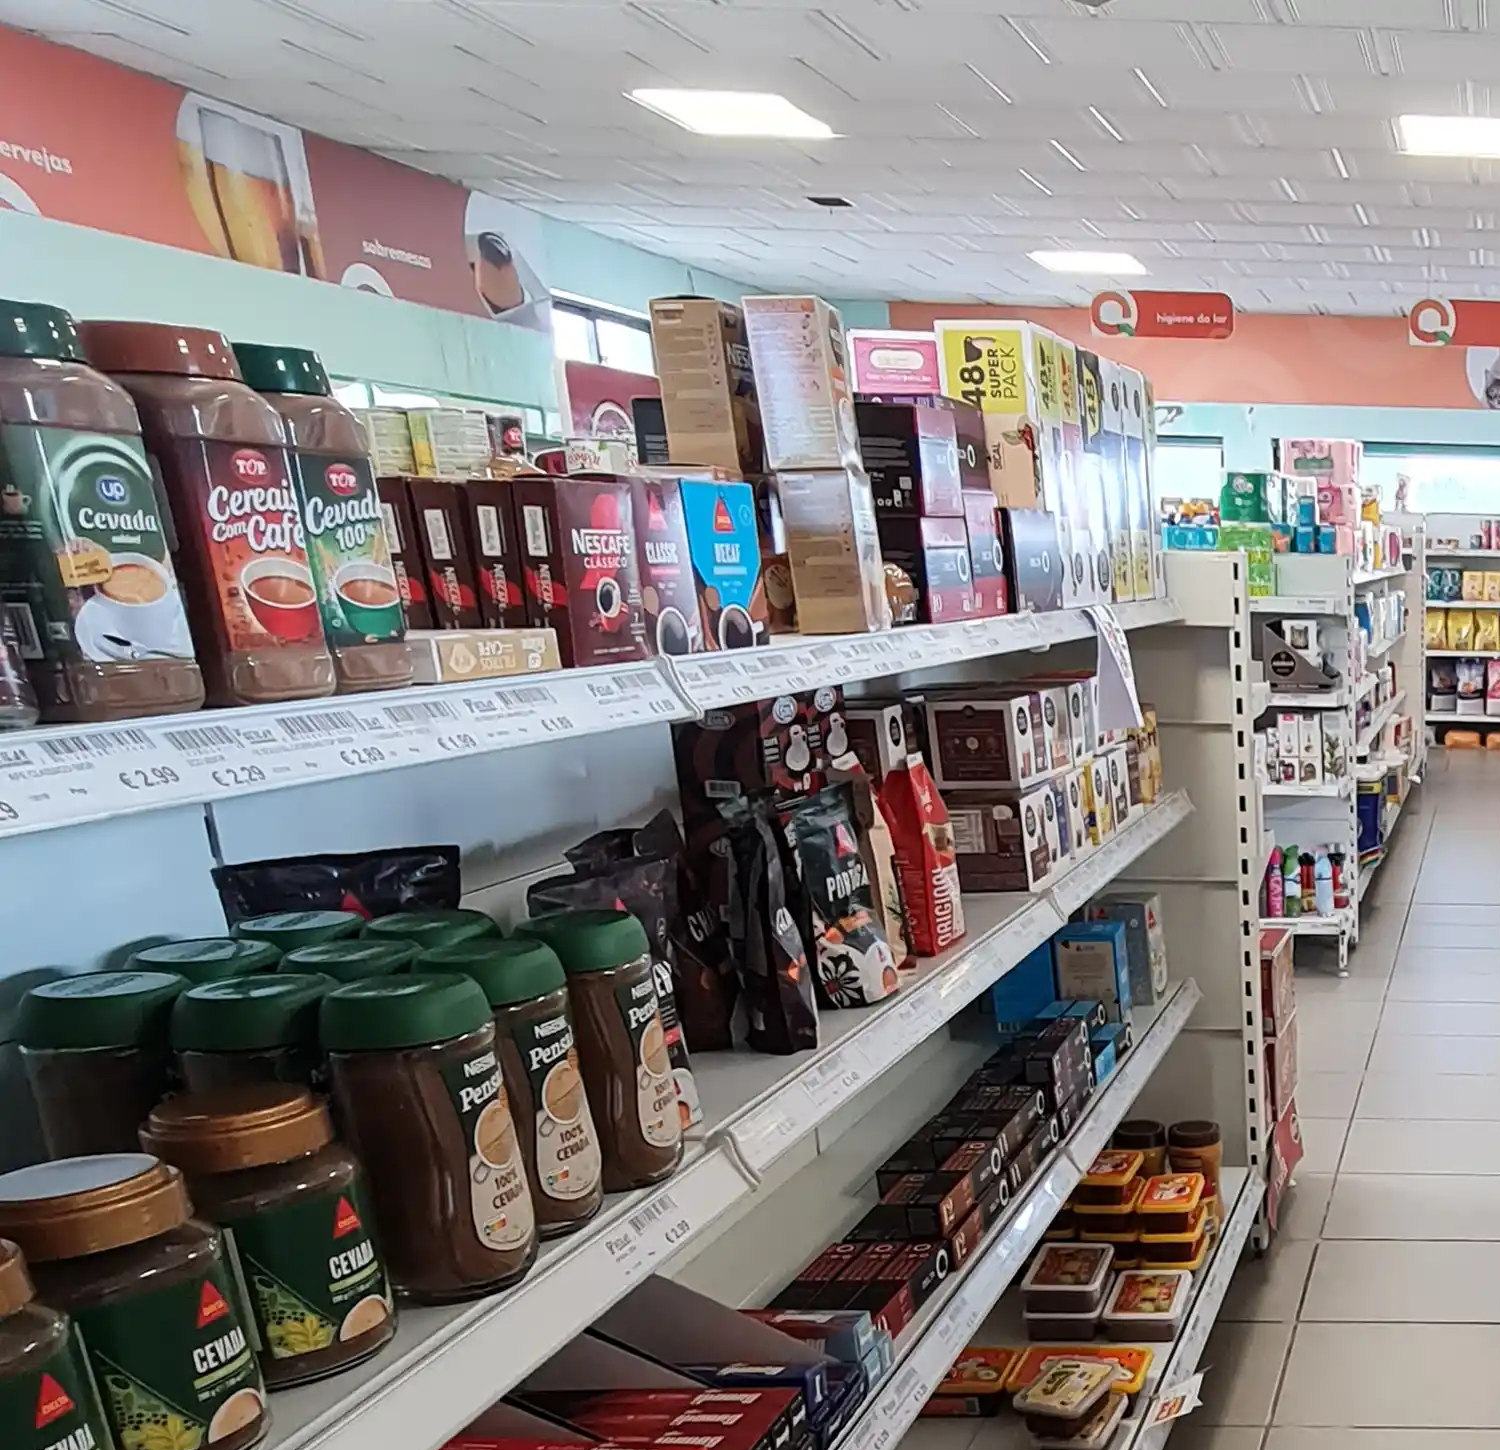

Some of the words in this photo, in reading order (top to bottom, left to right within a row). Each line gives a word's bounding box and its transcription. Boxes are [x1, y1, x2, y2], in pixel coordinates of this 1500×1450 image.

[361, 239, 433, 270] sobremesas
[1156, 312, 1194, 326] higiene
[990, 348, 1002, 399] SUPER
[1003, 347, 1020, 400] PACK
[78, 506, 159, 532] Cevada
